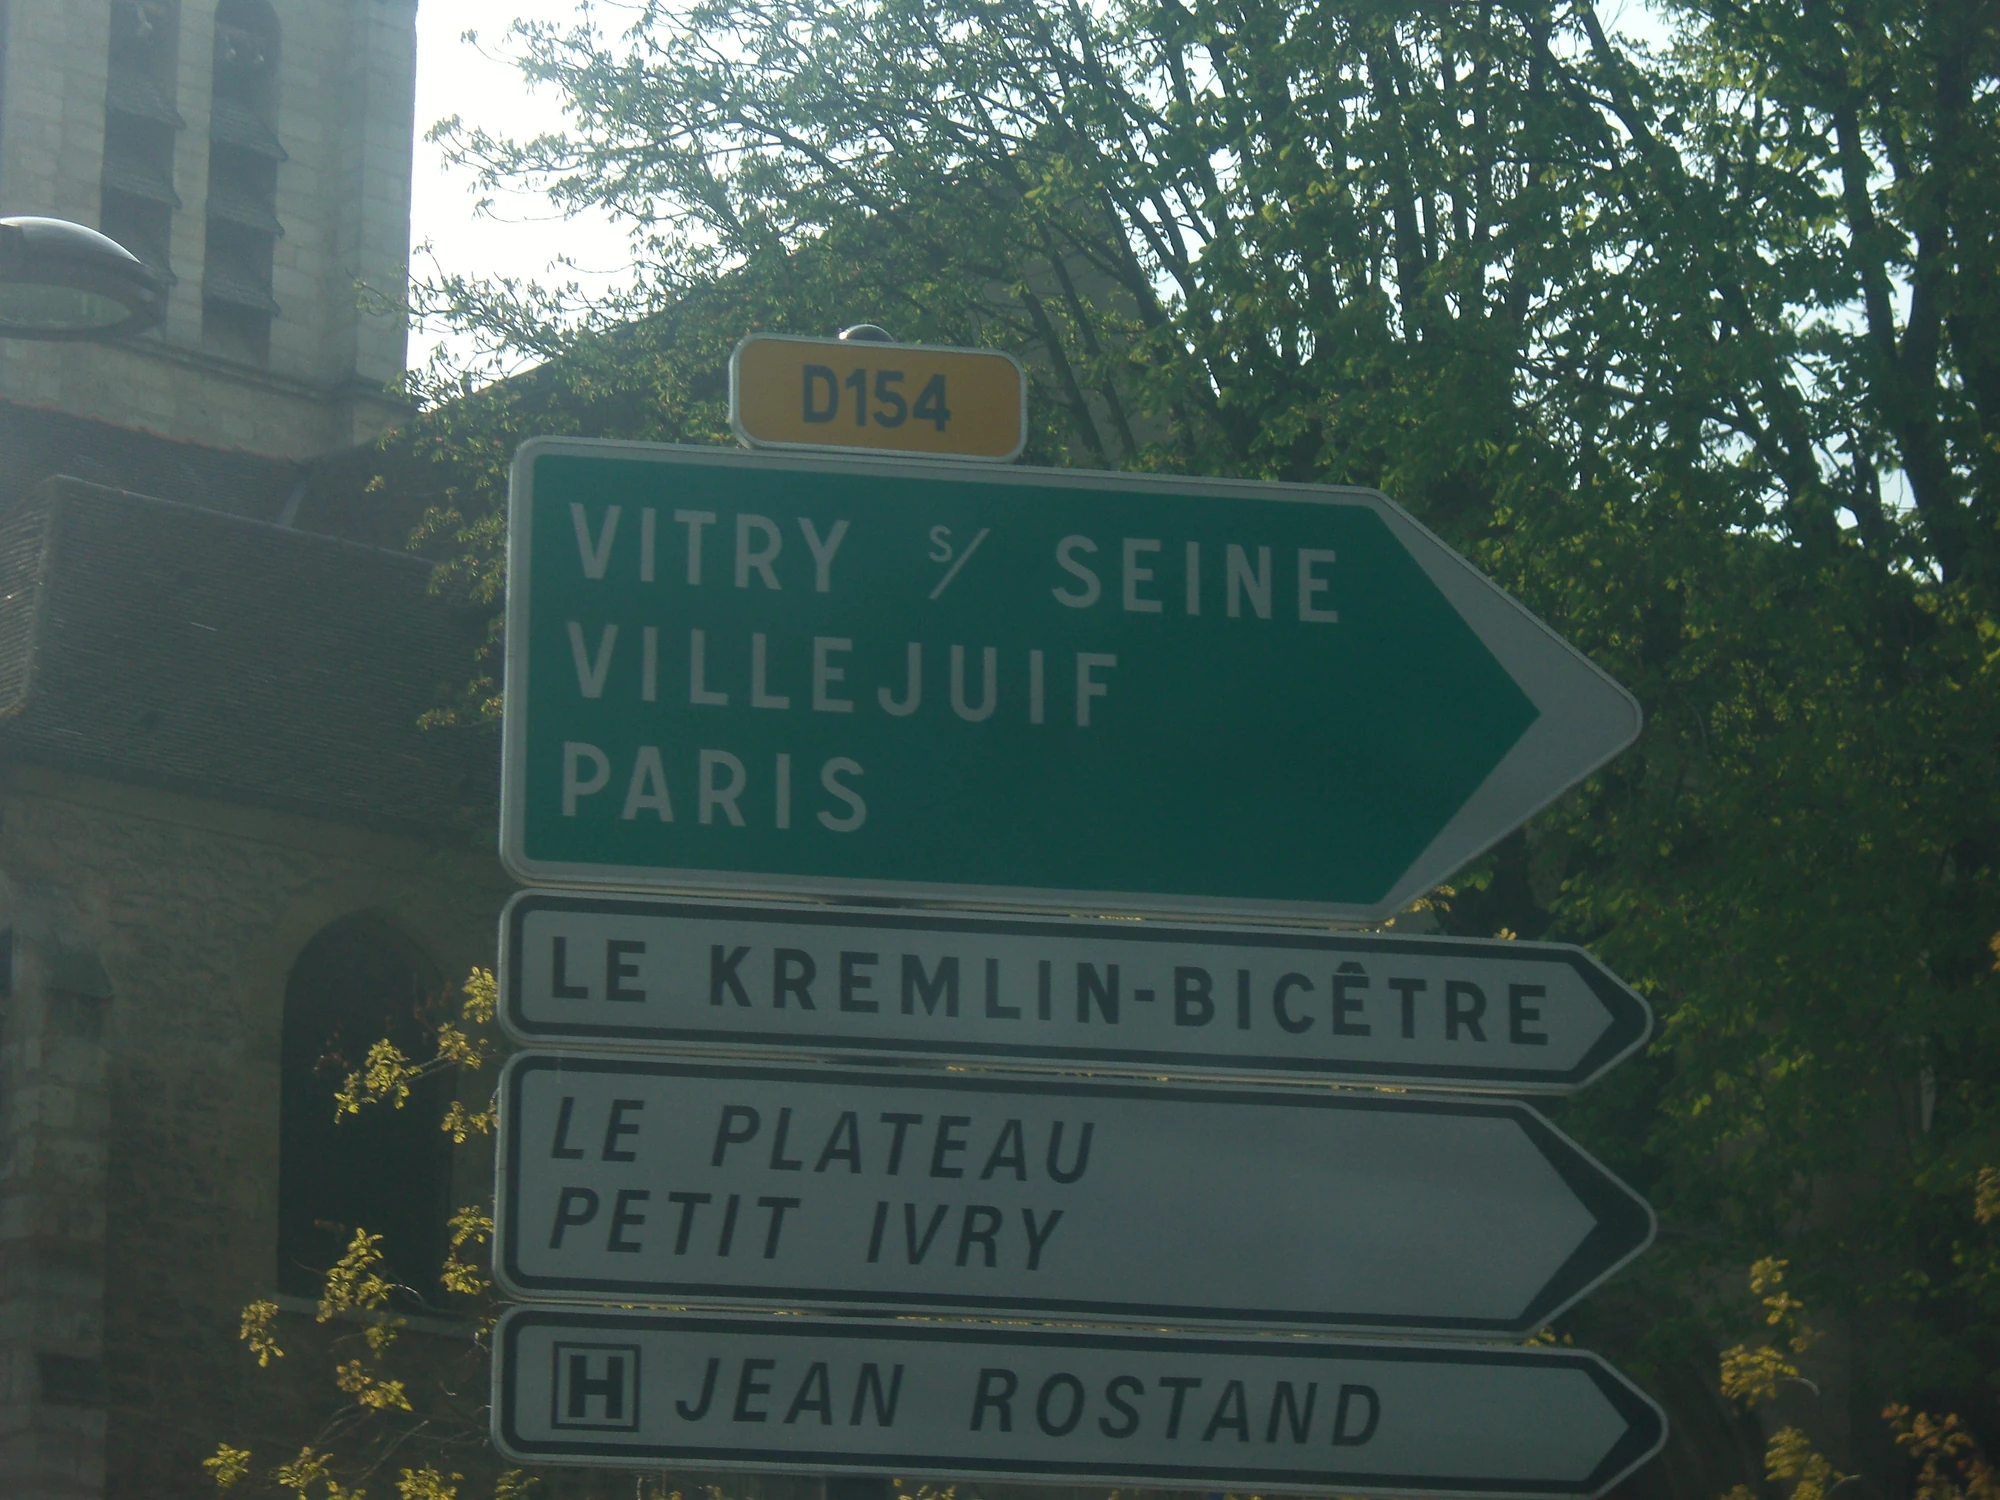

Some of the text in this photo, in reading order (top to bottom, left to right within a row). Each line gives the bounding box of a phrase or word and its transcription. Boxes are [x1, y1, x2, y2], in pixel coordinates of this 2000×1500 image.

[804, 365, 952, 433] D154
[569, 502, 848, 591] VITRY
[1052, 534, 1337, 622] SEINE
[565, 619, 1116, 725] VILLEJUIF
[562, 741, 866, 832] PARIS
[552, 937, 1550, 1047] LE KREMLIN-BICÊTRE
[551, 1097, 1094, 1184] LE PLATEAU
[549, 1187, 1064, 1270] PETIT IVRY
[676, 1358, 904, 1427] JEAN
[970, 1369, 1380, 1446] ROSTAND
